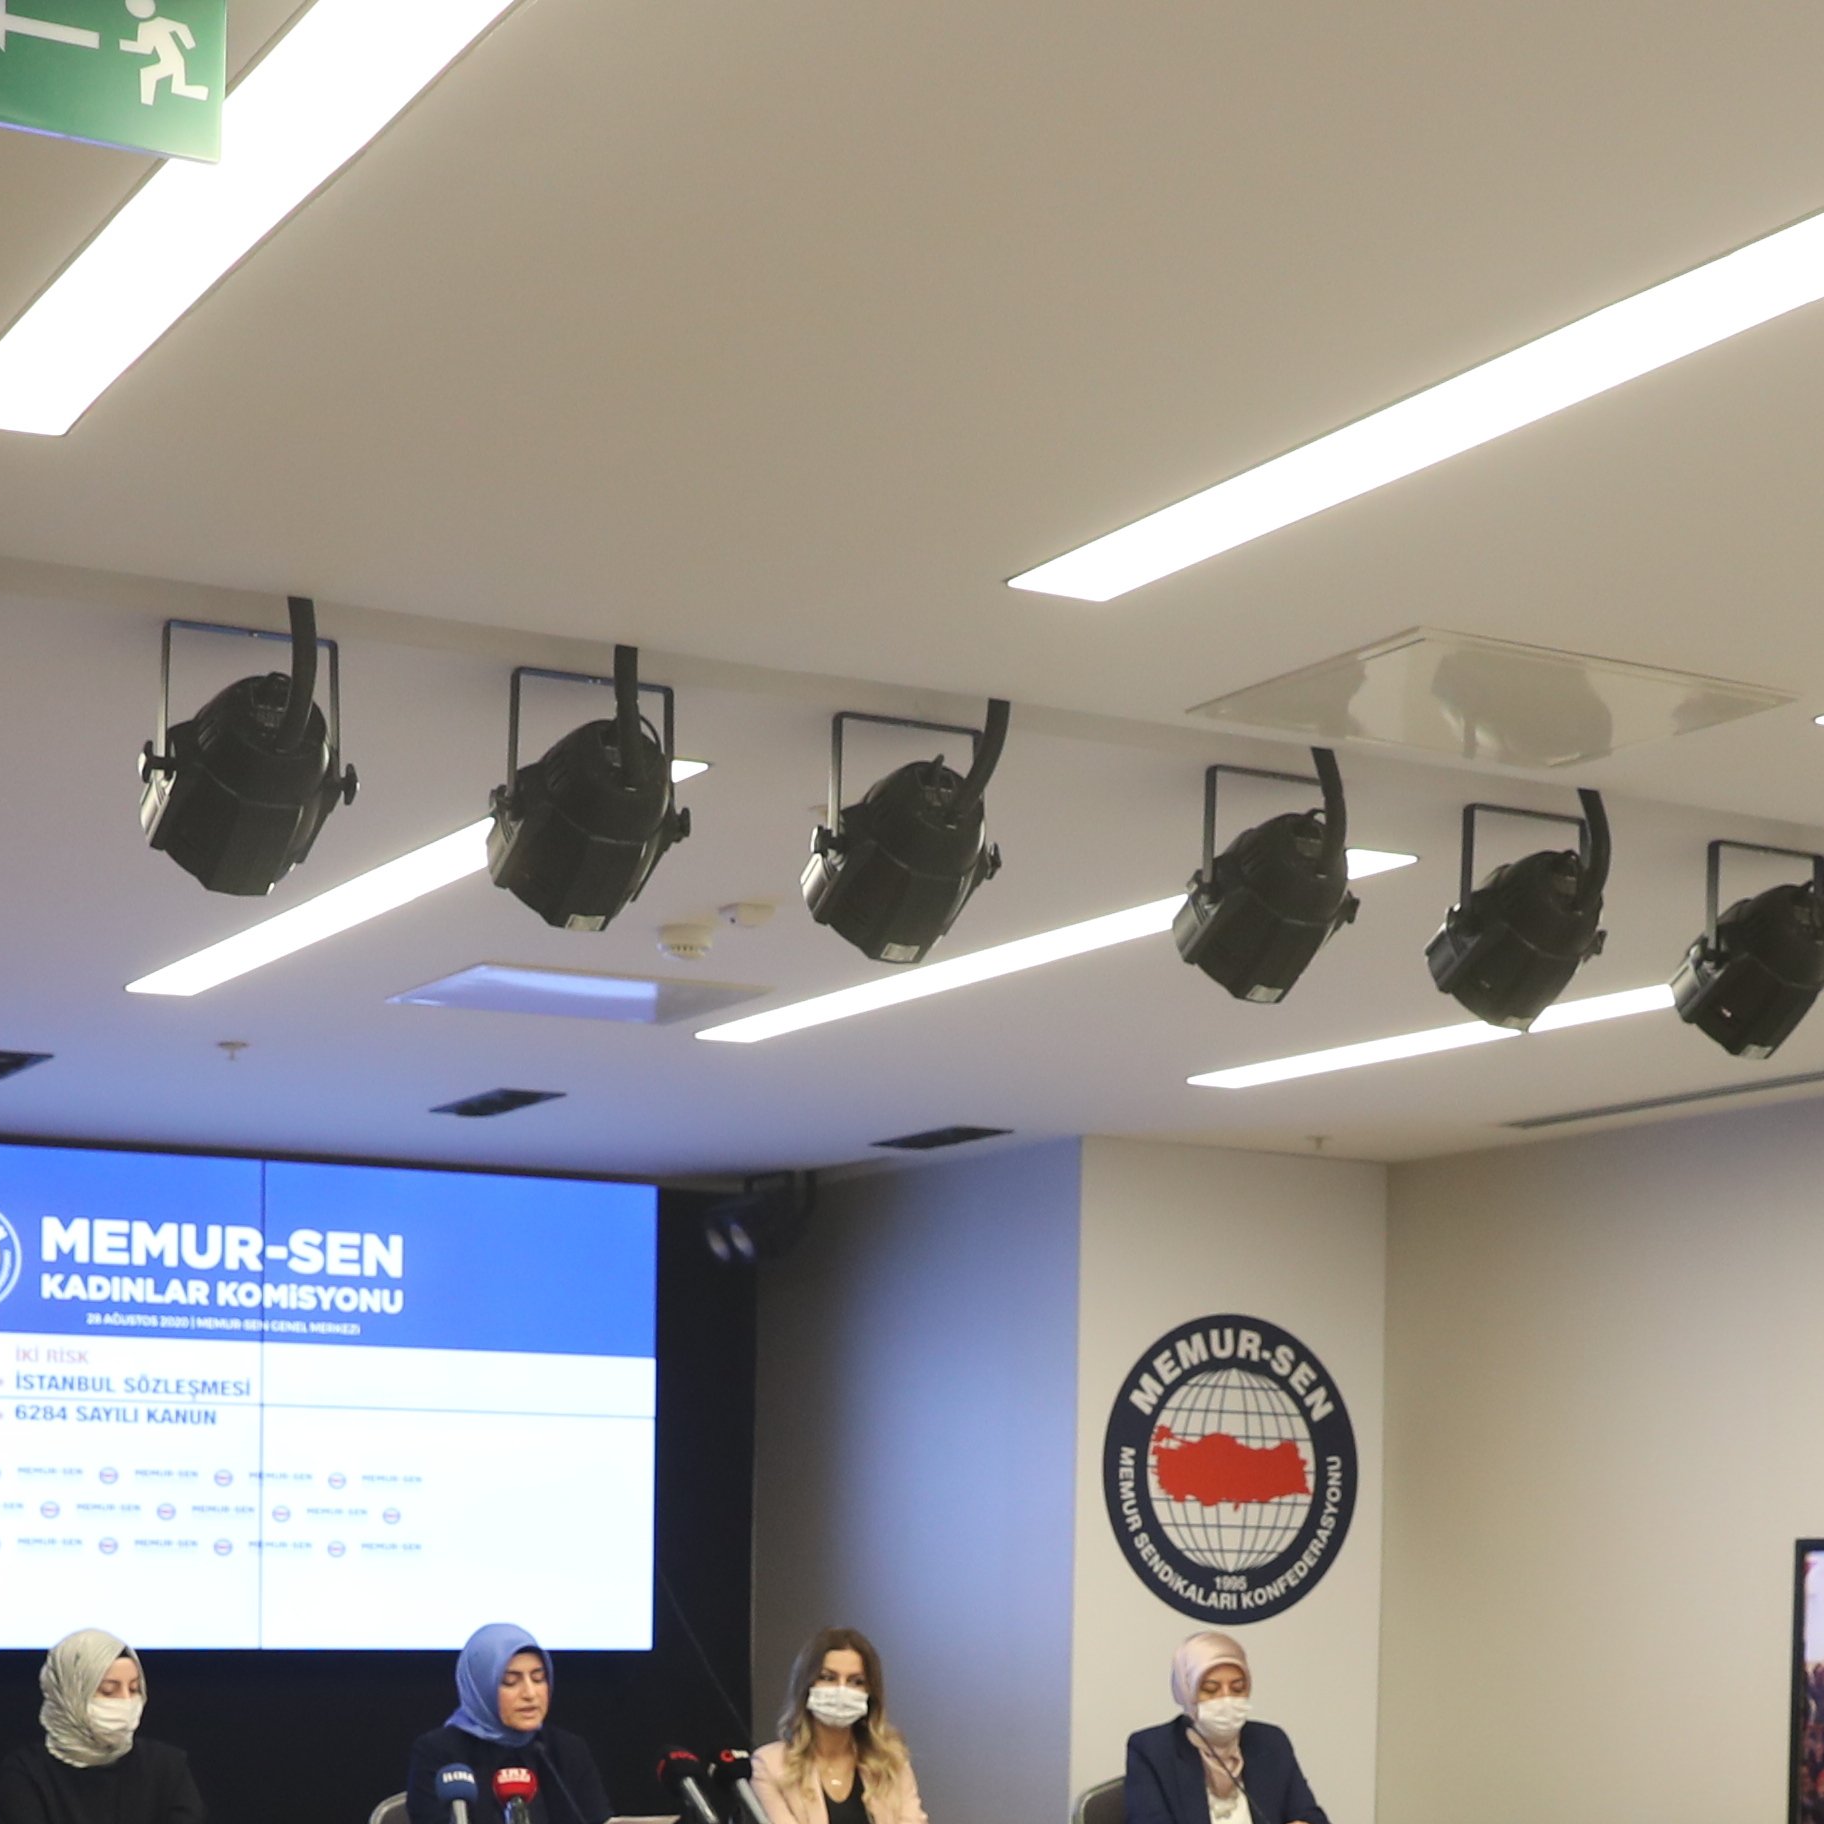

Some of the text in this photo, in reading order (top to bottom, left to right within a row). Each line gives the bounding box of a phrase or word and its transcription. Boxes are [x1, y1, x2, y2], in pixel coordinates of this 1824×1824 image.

[41, 1216, 404, 1278] MEMUR-SEN
[40, 1273, 210, 1307] KADINLAR
[46, 1347, 90, 1365] RİSK
[15, 1371, 252, 1400] İSTANBUL SÖZLEŞMESİ
[1129, 1327, 1334, 1422] MEMUR-SEN
[15, 1404, 218, 1426] 6284 SAYILI KANUN
[1119, 1446, 1143, 1533] MEMUR
[1241, 1455, 1342, 1610] KONFEDERASYONU
